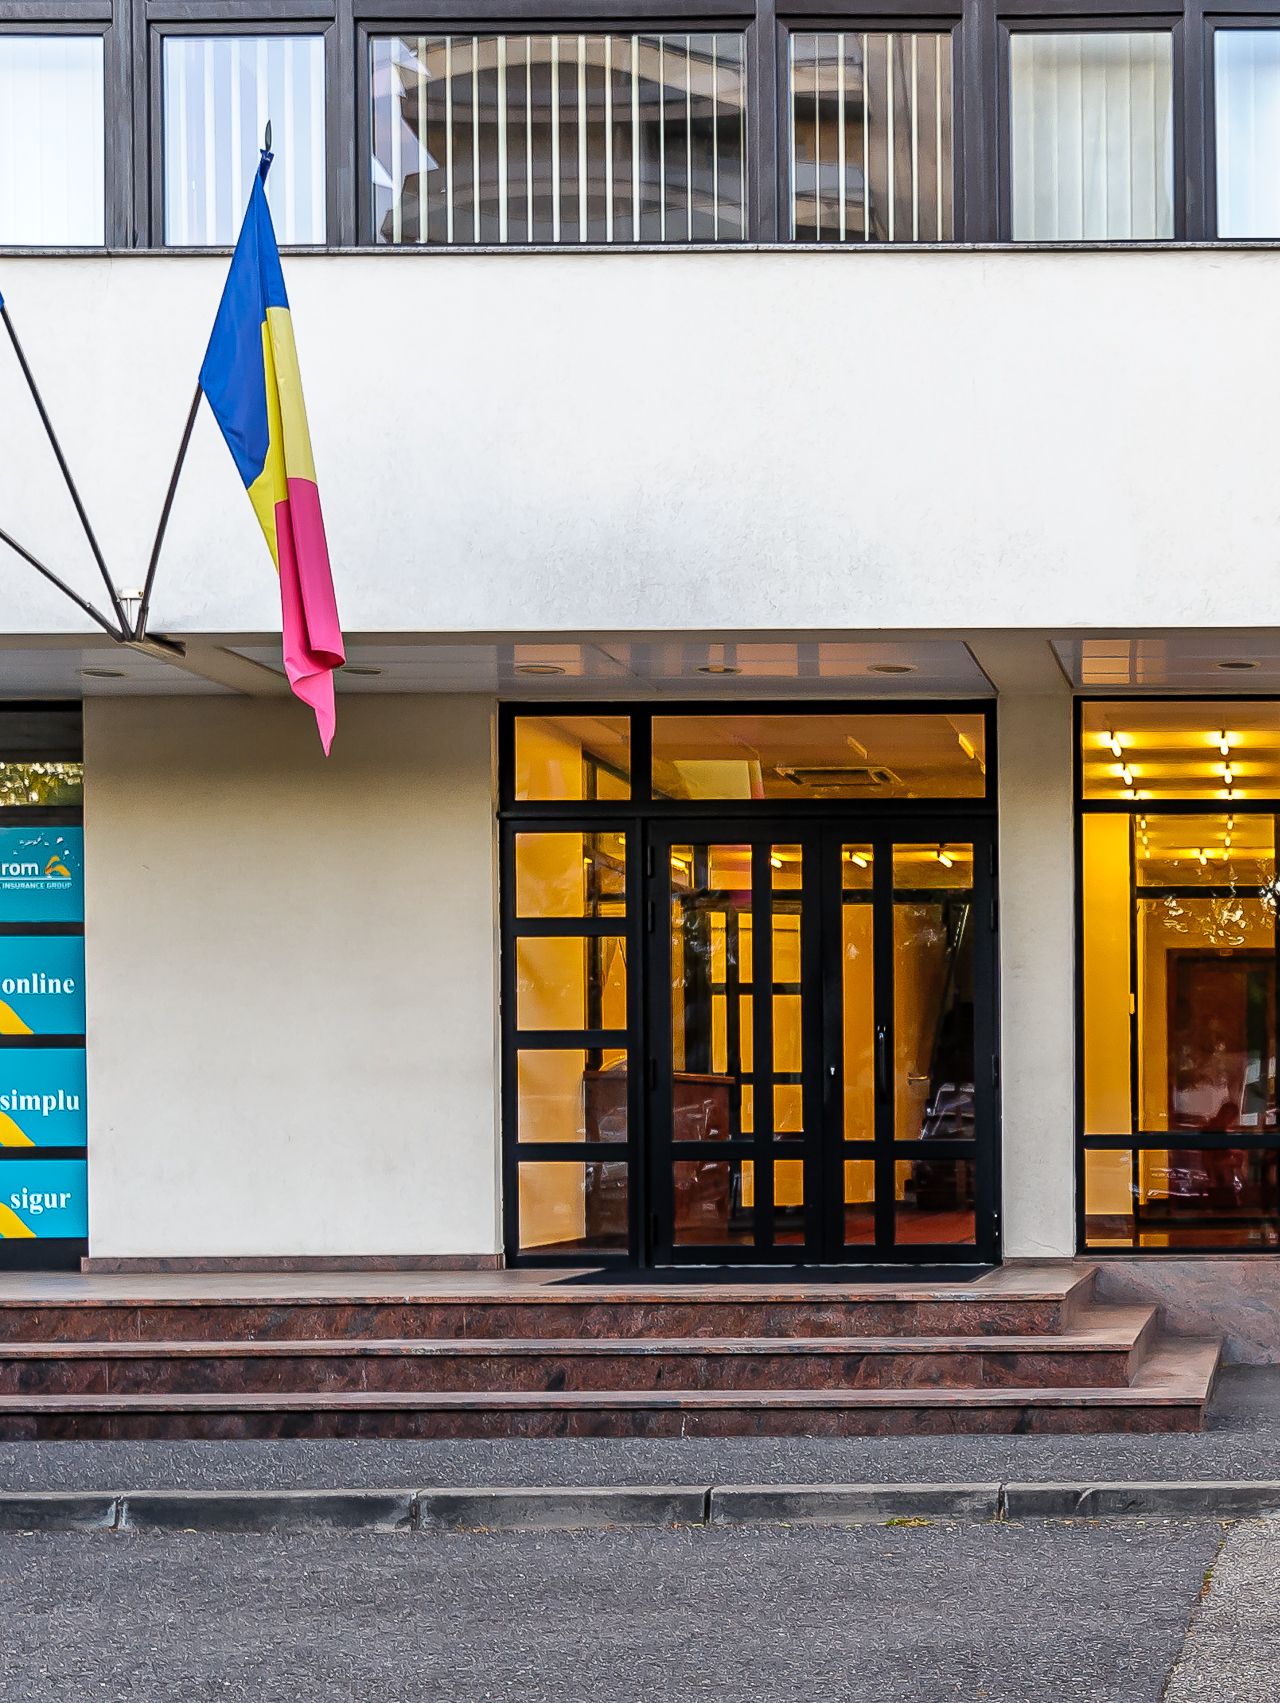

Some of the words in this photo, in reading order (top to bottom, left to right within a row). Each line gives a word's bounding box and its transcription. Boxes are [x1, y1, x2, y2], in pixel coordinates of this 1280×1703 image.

[2, 882, 45, 890] INSURANCE
[46, 882, 72, 890] GROUP
[2, 972, 75, 995] online
[0, 1088, 80, 1117] simplu
[10, 1187, 72, 1215] sigur
